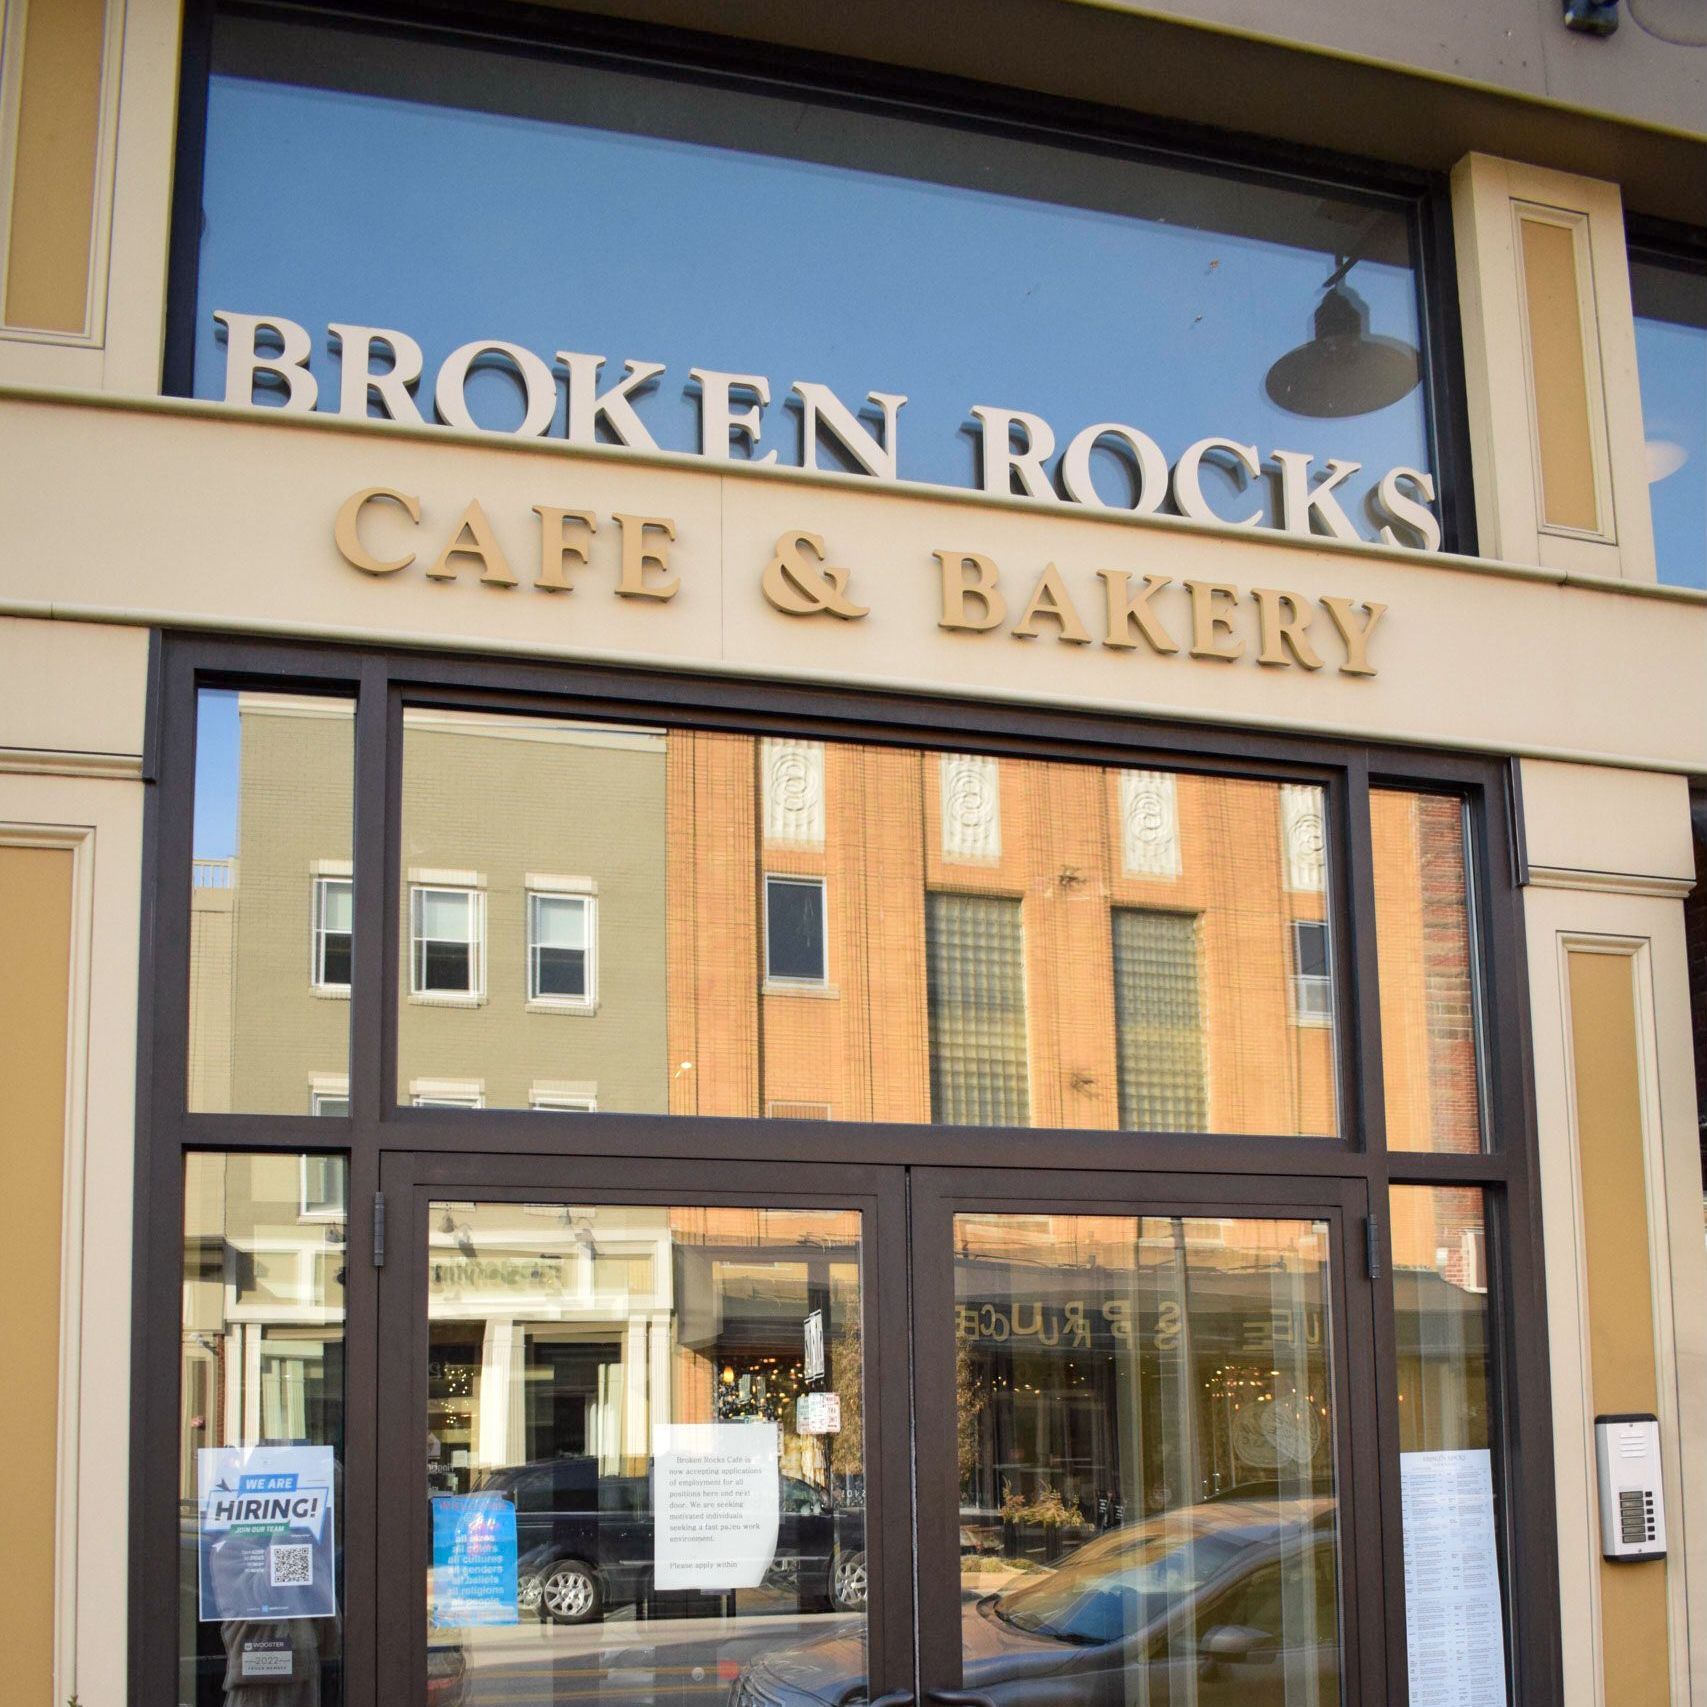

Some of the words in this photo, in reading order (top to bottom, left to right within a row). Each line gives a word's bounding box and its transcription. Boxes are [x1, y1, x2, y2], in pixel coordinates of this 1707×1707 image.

[213, 310, 908, 481] BROKEN
[969, 405, 1441, 553] ROCKS
[334, 486, 682, 603] CAFE
[761, 530, 871, 620] &
[932, 548, 1388, 677] BAKERY
[676, 1456, 702, 1464] Broken
[704, 1456, 725, 1464] Rocks
[686, 1467, 719, 1475] accepting
[721, 1466, 762, 1475] applications
[246, 1479, 265, 1489] WE
[268, 1478, 293, 1488] ARE
[679, 1479, 721, 1487] employment
[669, 1490, 701, 1498] positions
[214, 1498, 319, 1521] HIRING!
[690, 1501, 701, 1509] We
[717, 1501, 744, 1509] seeking
[669, 1512, 705, 1520] motivated
[706, 1512, 743, 1520] individuals
[236, 1526, 251, 1534] JOIN
[251, 1525, 266, 1533] OUR
[669, 1523, 697, 1532] seeking
[705, 1523, 718, 1531] fast
[670, 1561, 693, 1569] Please
[695, 1561, 714, 1570] apply
[716, 1560, 737, 1568] within
[463, 1565, 503, 1576] genders
[252, 1641, 284, 1649] WOOSTER
[255, 1656, 279, 1665] 2022
